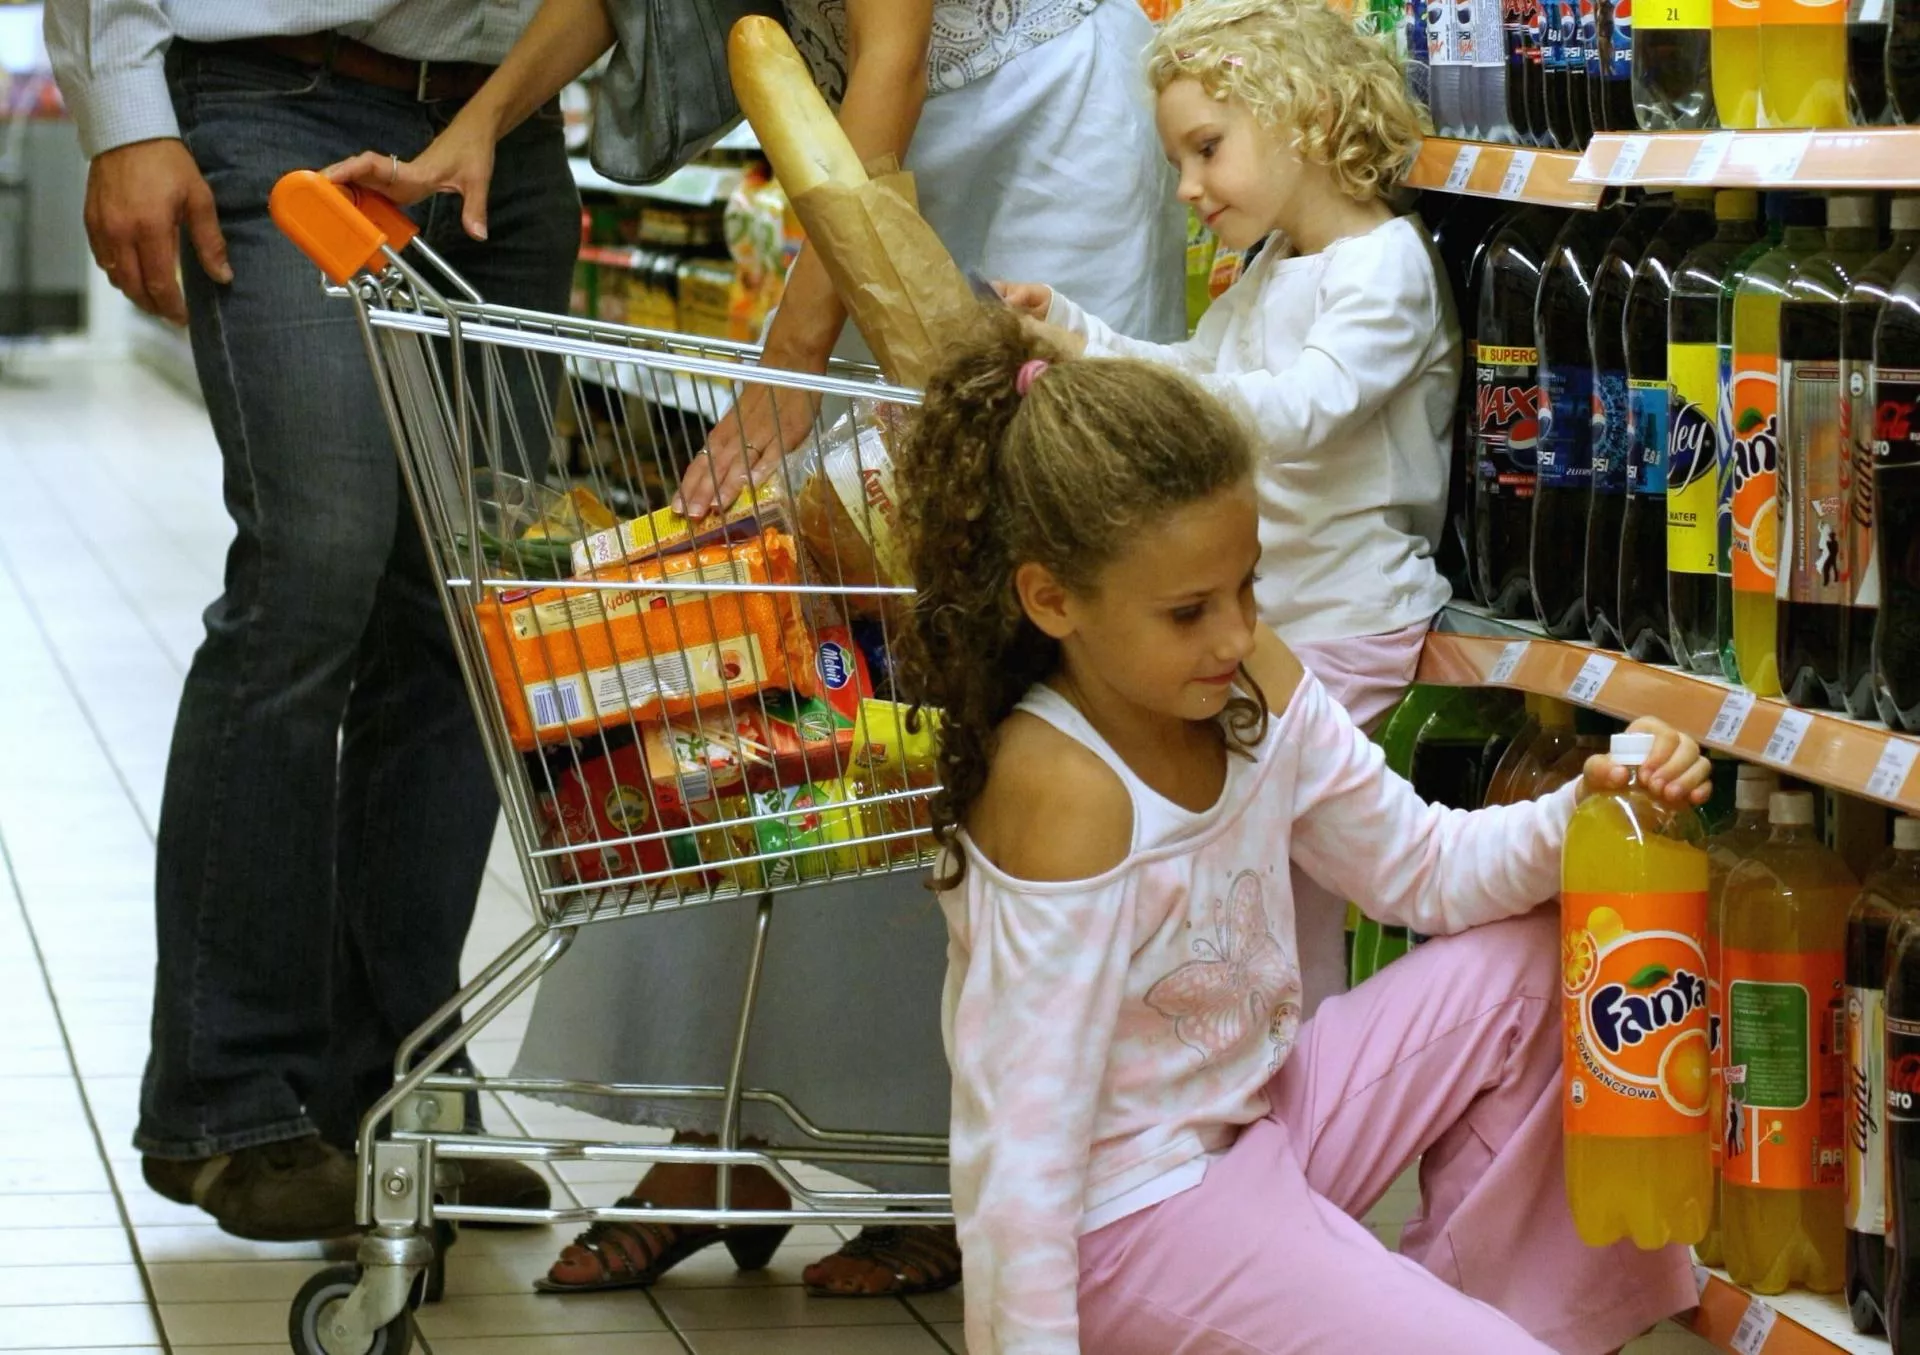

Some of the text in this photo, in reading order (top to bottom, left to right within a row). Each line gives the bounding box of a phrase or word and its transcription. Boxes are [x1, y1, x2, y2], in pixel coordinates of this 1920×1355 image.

[1666, 8, 1680, 21] 2L
[1707, 553, 1716, 567] 2
[822, 648, 843, 685] Melvit
[1590, 968, 1706, 1054] Fanta
[1575, 1033, 1658, 1100] POMARAŃCZOWA
